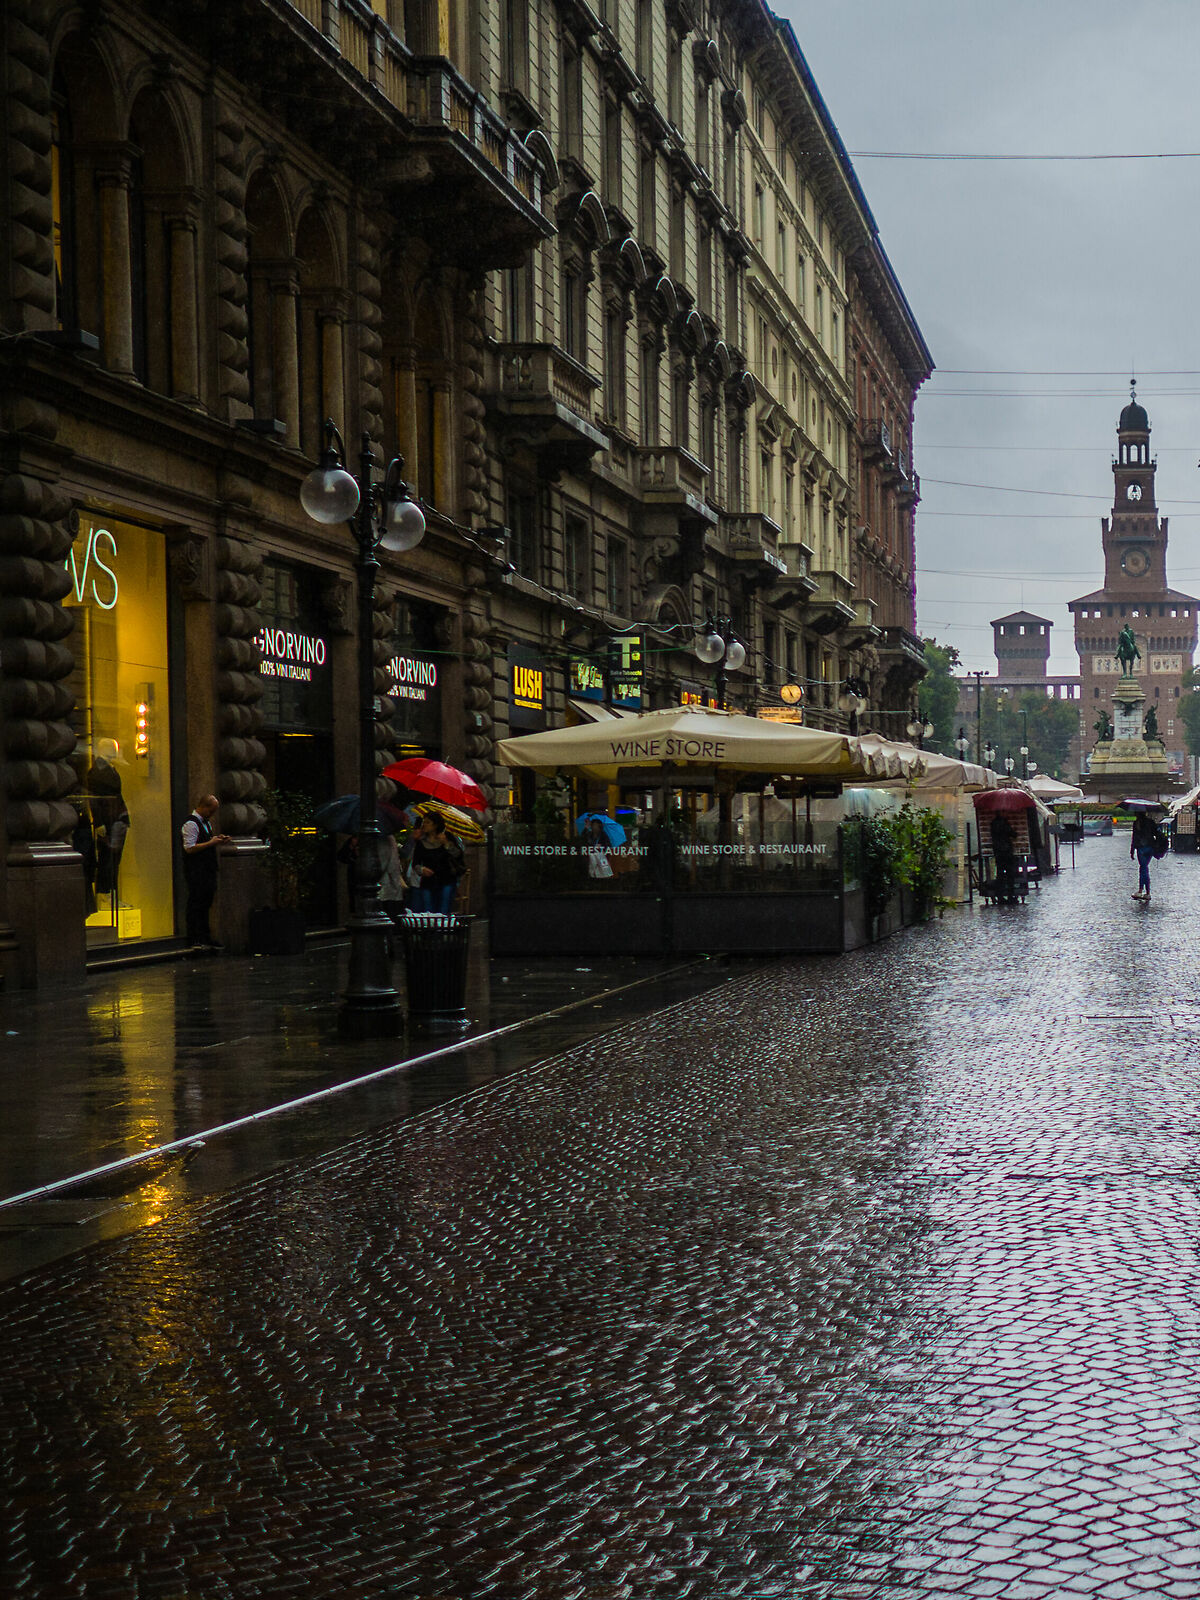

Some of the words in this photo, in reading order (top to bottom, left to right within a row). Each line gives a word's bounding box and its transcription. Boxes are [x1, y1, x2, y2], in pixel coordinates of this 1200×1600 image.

[64, 527, 119, 610] VS
[513, 665, 543, 700] LUSH
[610, 740, 660, 758] WINE
[665, 738, 726, 759] STORE
[502, 845, 531, 856] WINE
[534, 845, 568, 856] STORE
[570, 846, 578, 856] &
[581, 846, 649, 857] RESTAURANT
[681, 844, 710, 855] WINE
[712, 844, 746, 855] STORE
[748, 845, 756, 855] &
[759, 844, 827, 855] RESTAURANT
